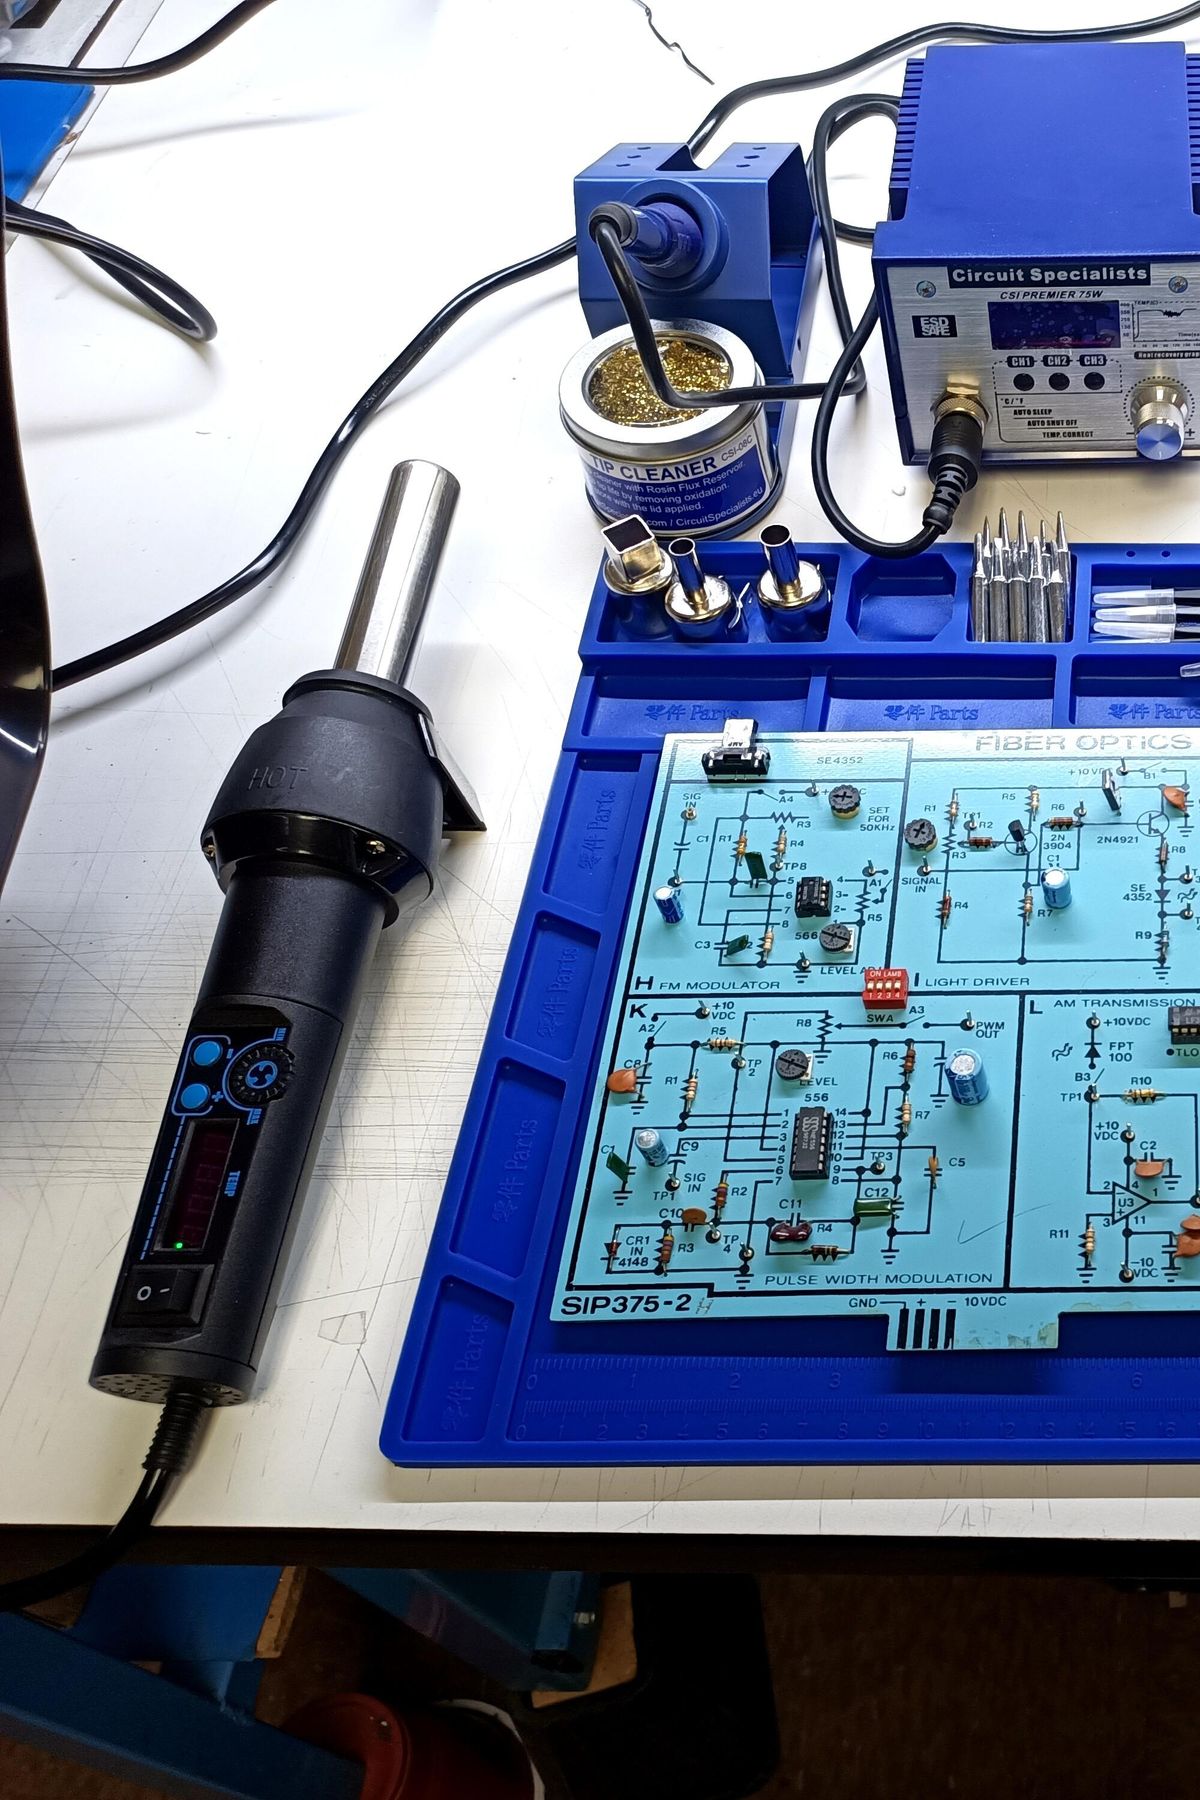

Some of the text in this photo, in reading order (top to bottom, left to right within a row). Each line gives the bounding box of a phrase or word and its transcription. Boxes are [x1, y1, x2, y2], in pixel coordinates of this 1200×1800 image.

[952, 267, 1147, 282] Circuit Specialists
[1000, 289, 1103, 299] CSI PREMIER 75W
[920, 316, 949, 327] ESD
[921, 325, 950, 336] SAFE
[1012, 357, 1031, 366] CH1
[1047, 356, 1067, 365] CH2
[1084, 355, 1104, 365] CH3
[721, 435, 753, 461] CSI-08C
[590, 454, 614, 473] TIP
[620, 456, 717, 481] CLEANER
[624, 461, 746, 494] with Rosin Flux Reservoir.
[635, 495, 682, 503] removing
[684, 483, 729, 500] oxidation.
[632, 503, 647, 512] the
[650, 504, 661, 513] lid
[665, 502, 704, 514] applied.
[676, 486, 763, 526] CircuitSpecialists.eu
[929, 705, 979, 722] Parts
[975, 735, 1065, 751] FIBER
[1076, 735, 1192, 750] OPTICS
[816, 757, 863, 765] SE4352
[248, 766, 308, 790] HOT
[682, 793, 701, 801] SIG
[868, 814, 890, 823] FOR
[859, 824, 895, 832] 50KHz
[1097, 836, 1139, 844] 2N4921
[783, 862, 807, 871] TP8
[901, 877, 942, 885] SIGNAL
[1123, 892, 1152, 901] 4352
[795, 932, 818, 940] 566
[820, 967, 857, 975] LEVEL
[635, 976, 780, 990] H FM MODULATOR
[925, 977, 969, 987] LIGHT
[973, 977, 1030, 986] DRIVER
[629, 1003, 648, 1018] K
[712, 1002, 735, 1010] +10
[1030, 1000, 1044, 1015] L
[1054, 999, 1076, 1008] AM
[1083, 998, 1196, 1008] TRANSMISSION
[711, 1012, 736, 1020] VDC
[866, 1014, 894, 1023] SWA
[976, 1022, 1005, 1030] PWM
[1103, 1017, 1151, 1026] +10VDC
[711, 1027, 727, 1035] R5
[975, 1030, 999, 1038] OUT
[1109, 1042, 1134, 1051] FPT
[1109, 1052, 1133, 1062] 100
[1130, 1076, 1152, 1086] R10
[805, 1093, 829, 1102] 556
[1061, 1092, 1082, 1102] TP1
[683, 1173, 706, 1182] SIG
[224, 1171, 240, 1197] TEMP
[653, 1192, 675, 1201] TP1
[864, 1188, 889, 1198] C12
[626, 1236, 650, 1245] CR1
[618, 1258, 649, 1267] 4148
[764, 1273, 993, 1286] PULSE WIDTH MODULATION
[561, 1294, 692, 1315] SIP375-2
[848, 1298, 877, 1308] GND
